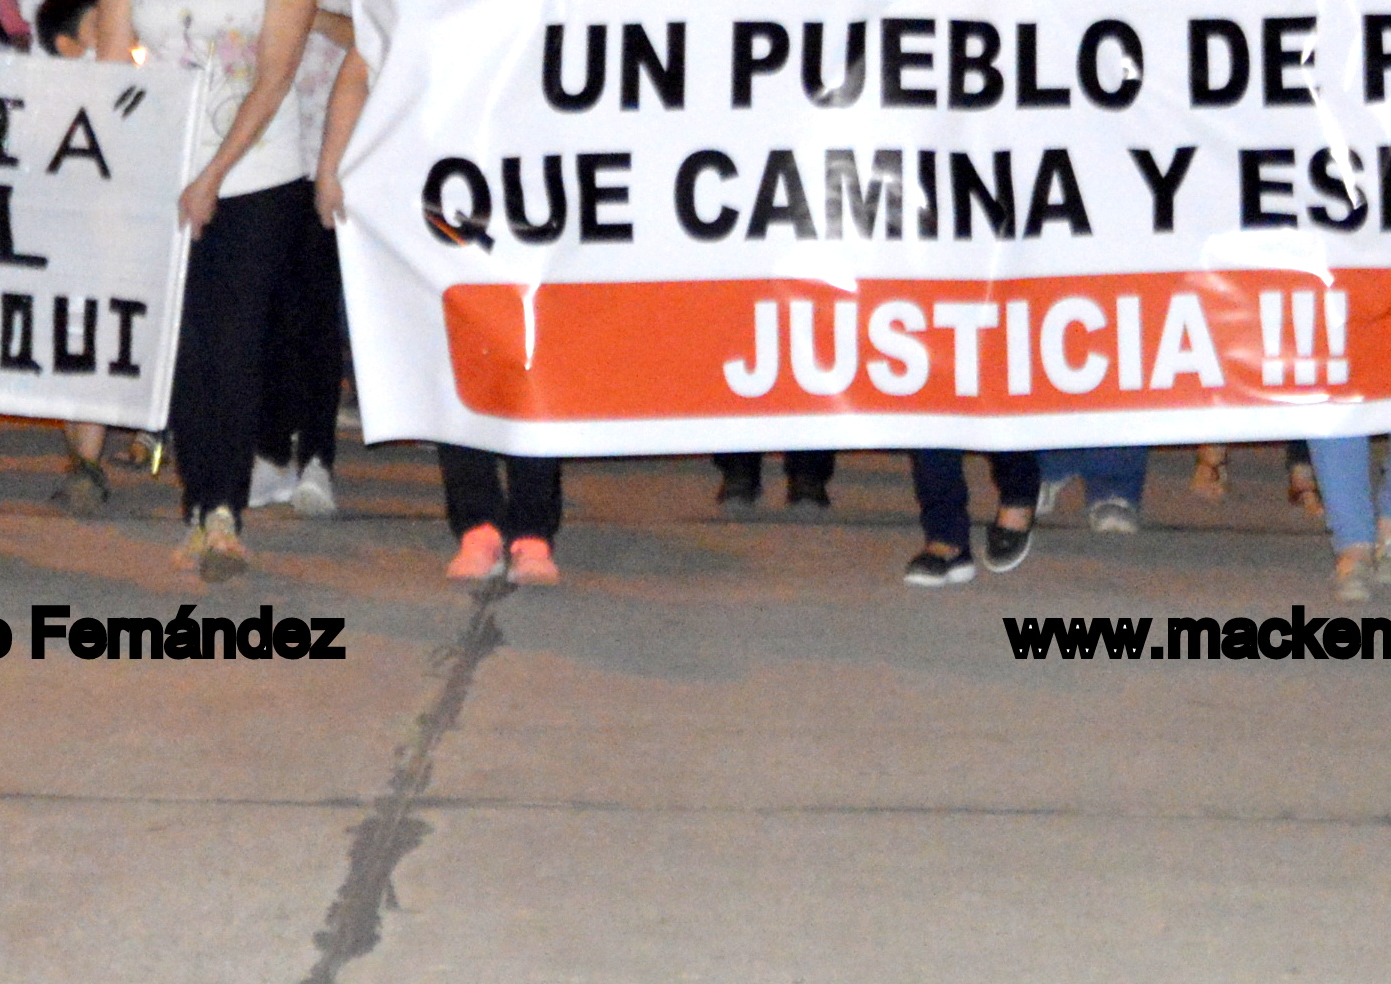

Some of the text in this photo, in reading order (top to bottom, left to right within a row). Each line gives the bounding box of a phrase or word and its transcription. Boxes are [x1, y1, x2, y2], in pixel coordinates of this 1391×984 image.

[541, 20, 687, 114] UN
[731, 17, 1145, 112] PUEBLO
[1187, 14, 1319, 110] DE
[421, 152, 634, 255] QUE
[673, 146, 1093, 244] CAMINA
[1129, 145, 1198, 234] Y
[721, 288, 1351, 399] JUSTICIA !!!
